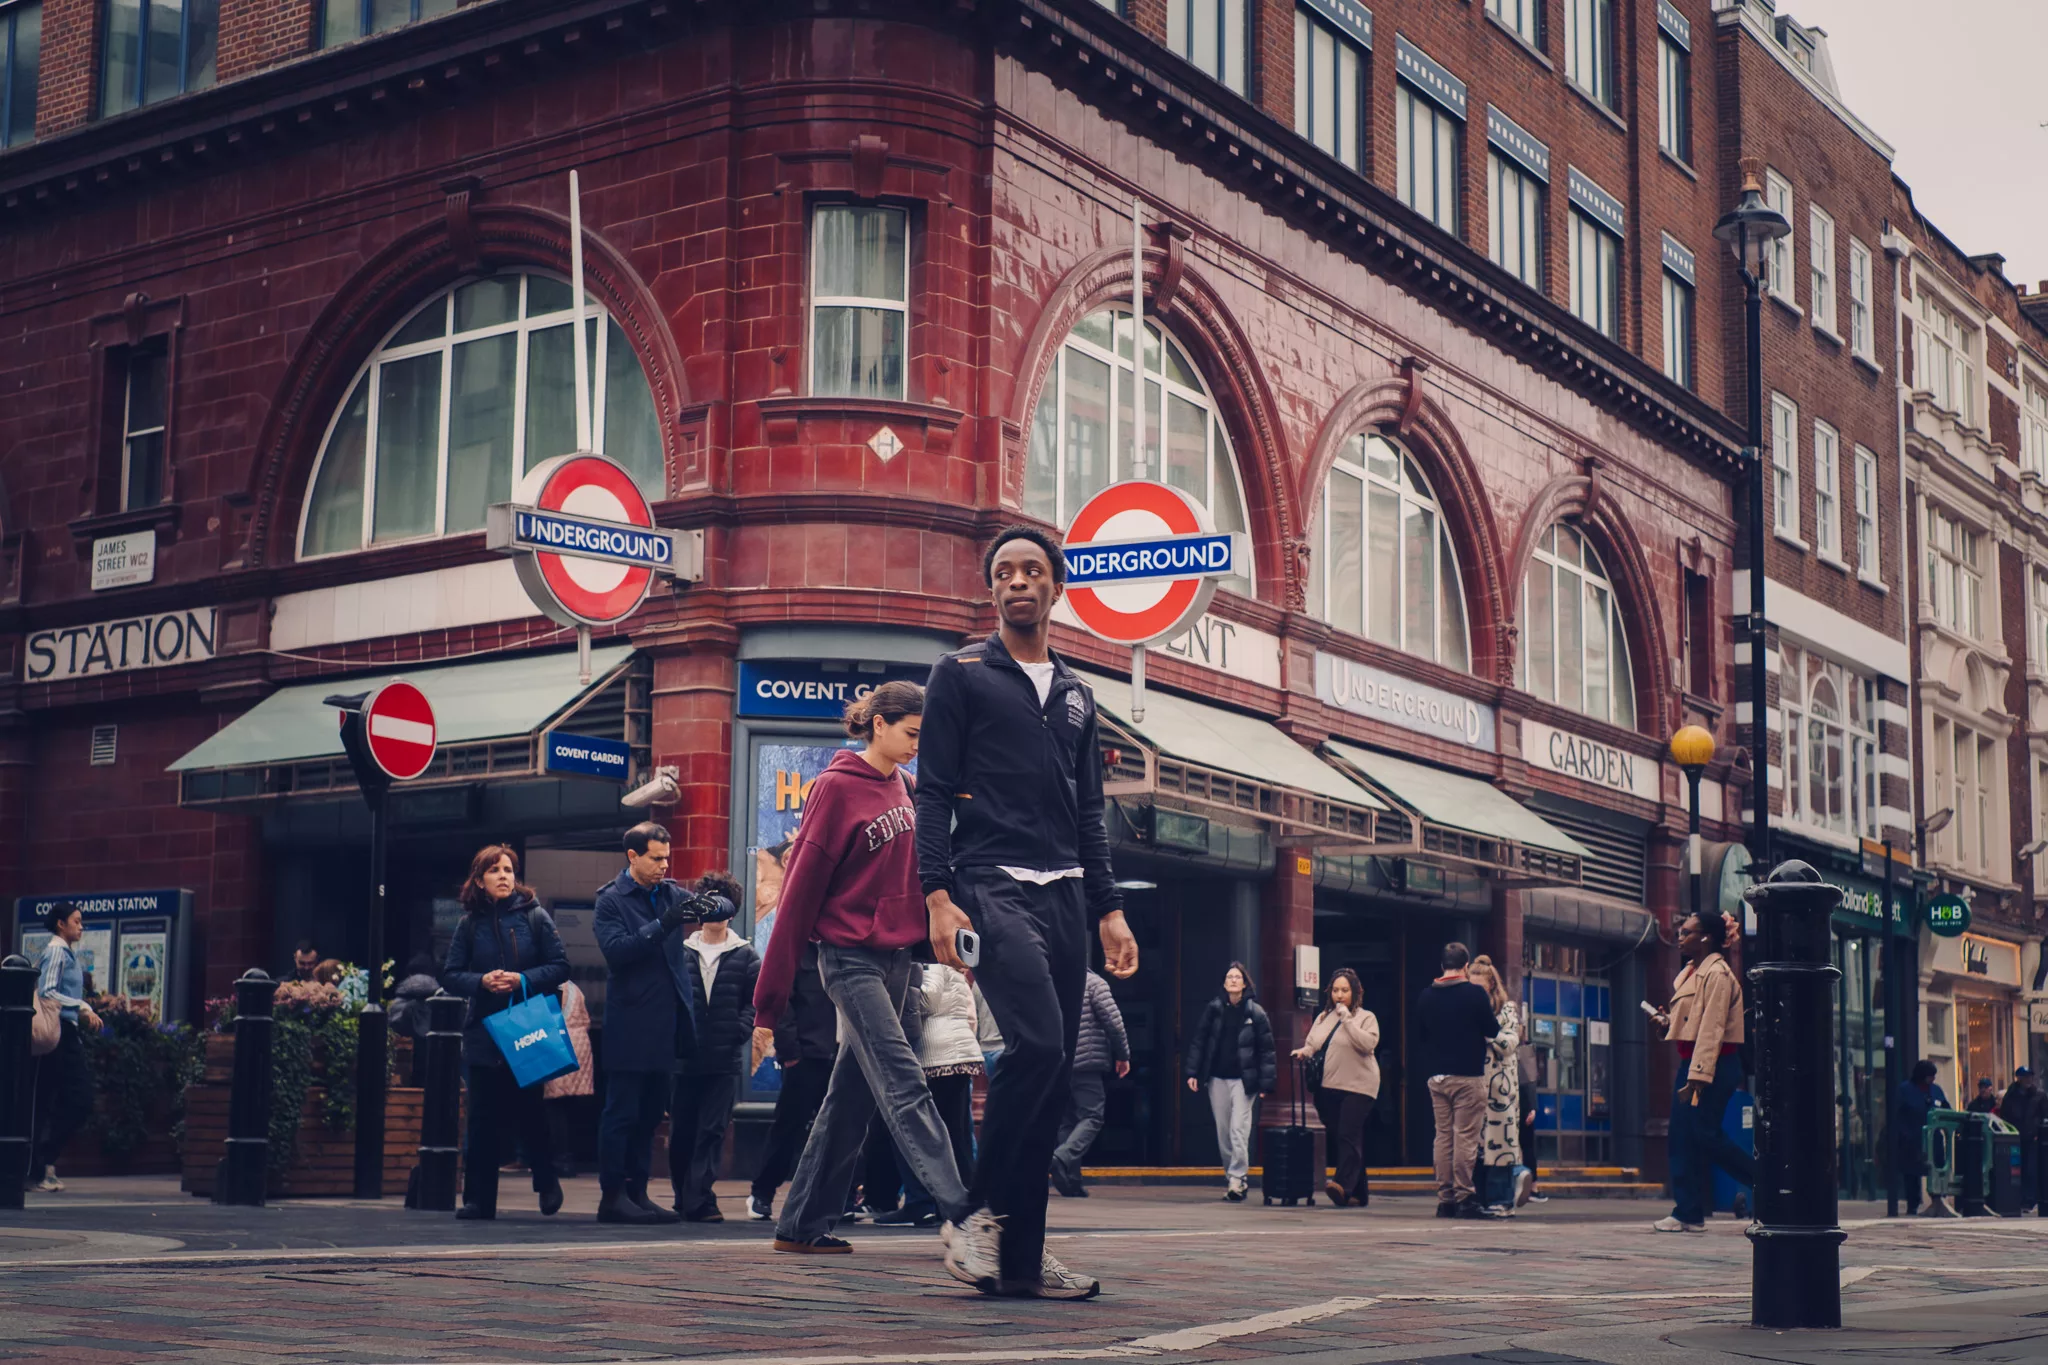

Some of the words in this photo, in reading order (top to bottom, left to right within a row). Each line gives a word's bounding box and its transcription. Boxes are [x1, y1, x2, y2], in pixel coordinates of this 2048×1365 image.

[98, 540, 126, 556] JAMES
[518, 513, 669, 562] UNDERGROUND
[97, 556, 126, 572] STREET
[130, 552, 148, 566] WC2
[1064, 541, 1229, 576] NDERGROUND
[28, 609, 216, 680] STATION
[756, 679, 848, 700] COVENT
[1331, 657, 1480, 744] UNDERGROUND
[555, 745, 590, 760] COVENT
[590, 751, 624, 765] GARDEN
[1549, 731, 1633, 791] GARDEN
[76, 898, 115, 912] GARDEN
[117, 896, 158, 911] STATION
[514, 1028, 548, 1051] HOKA
